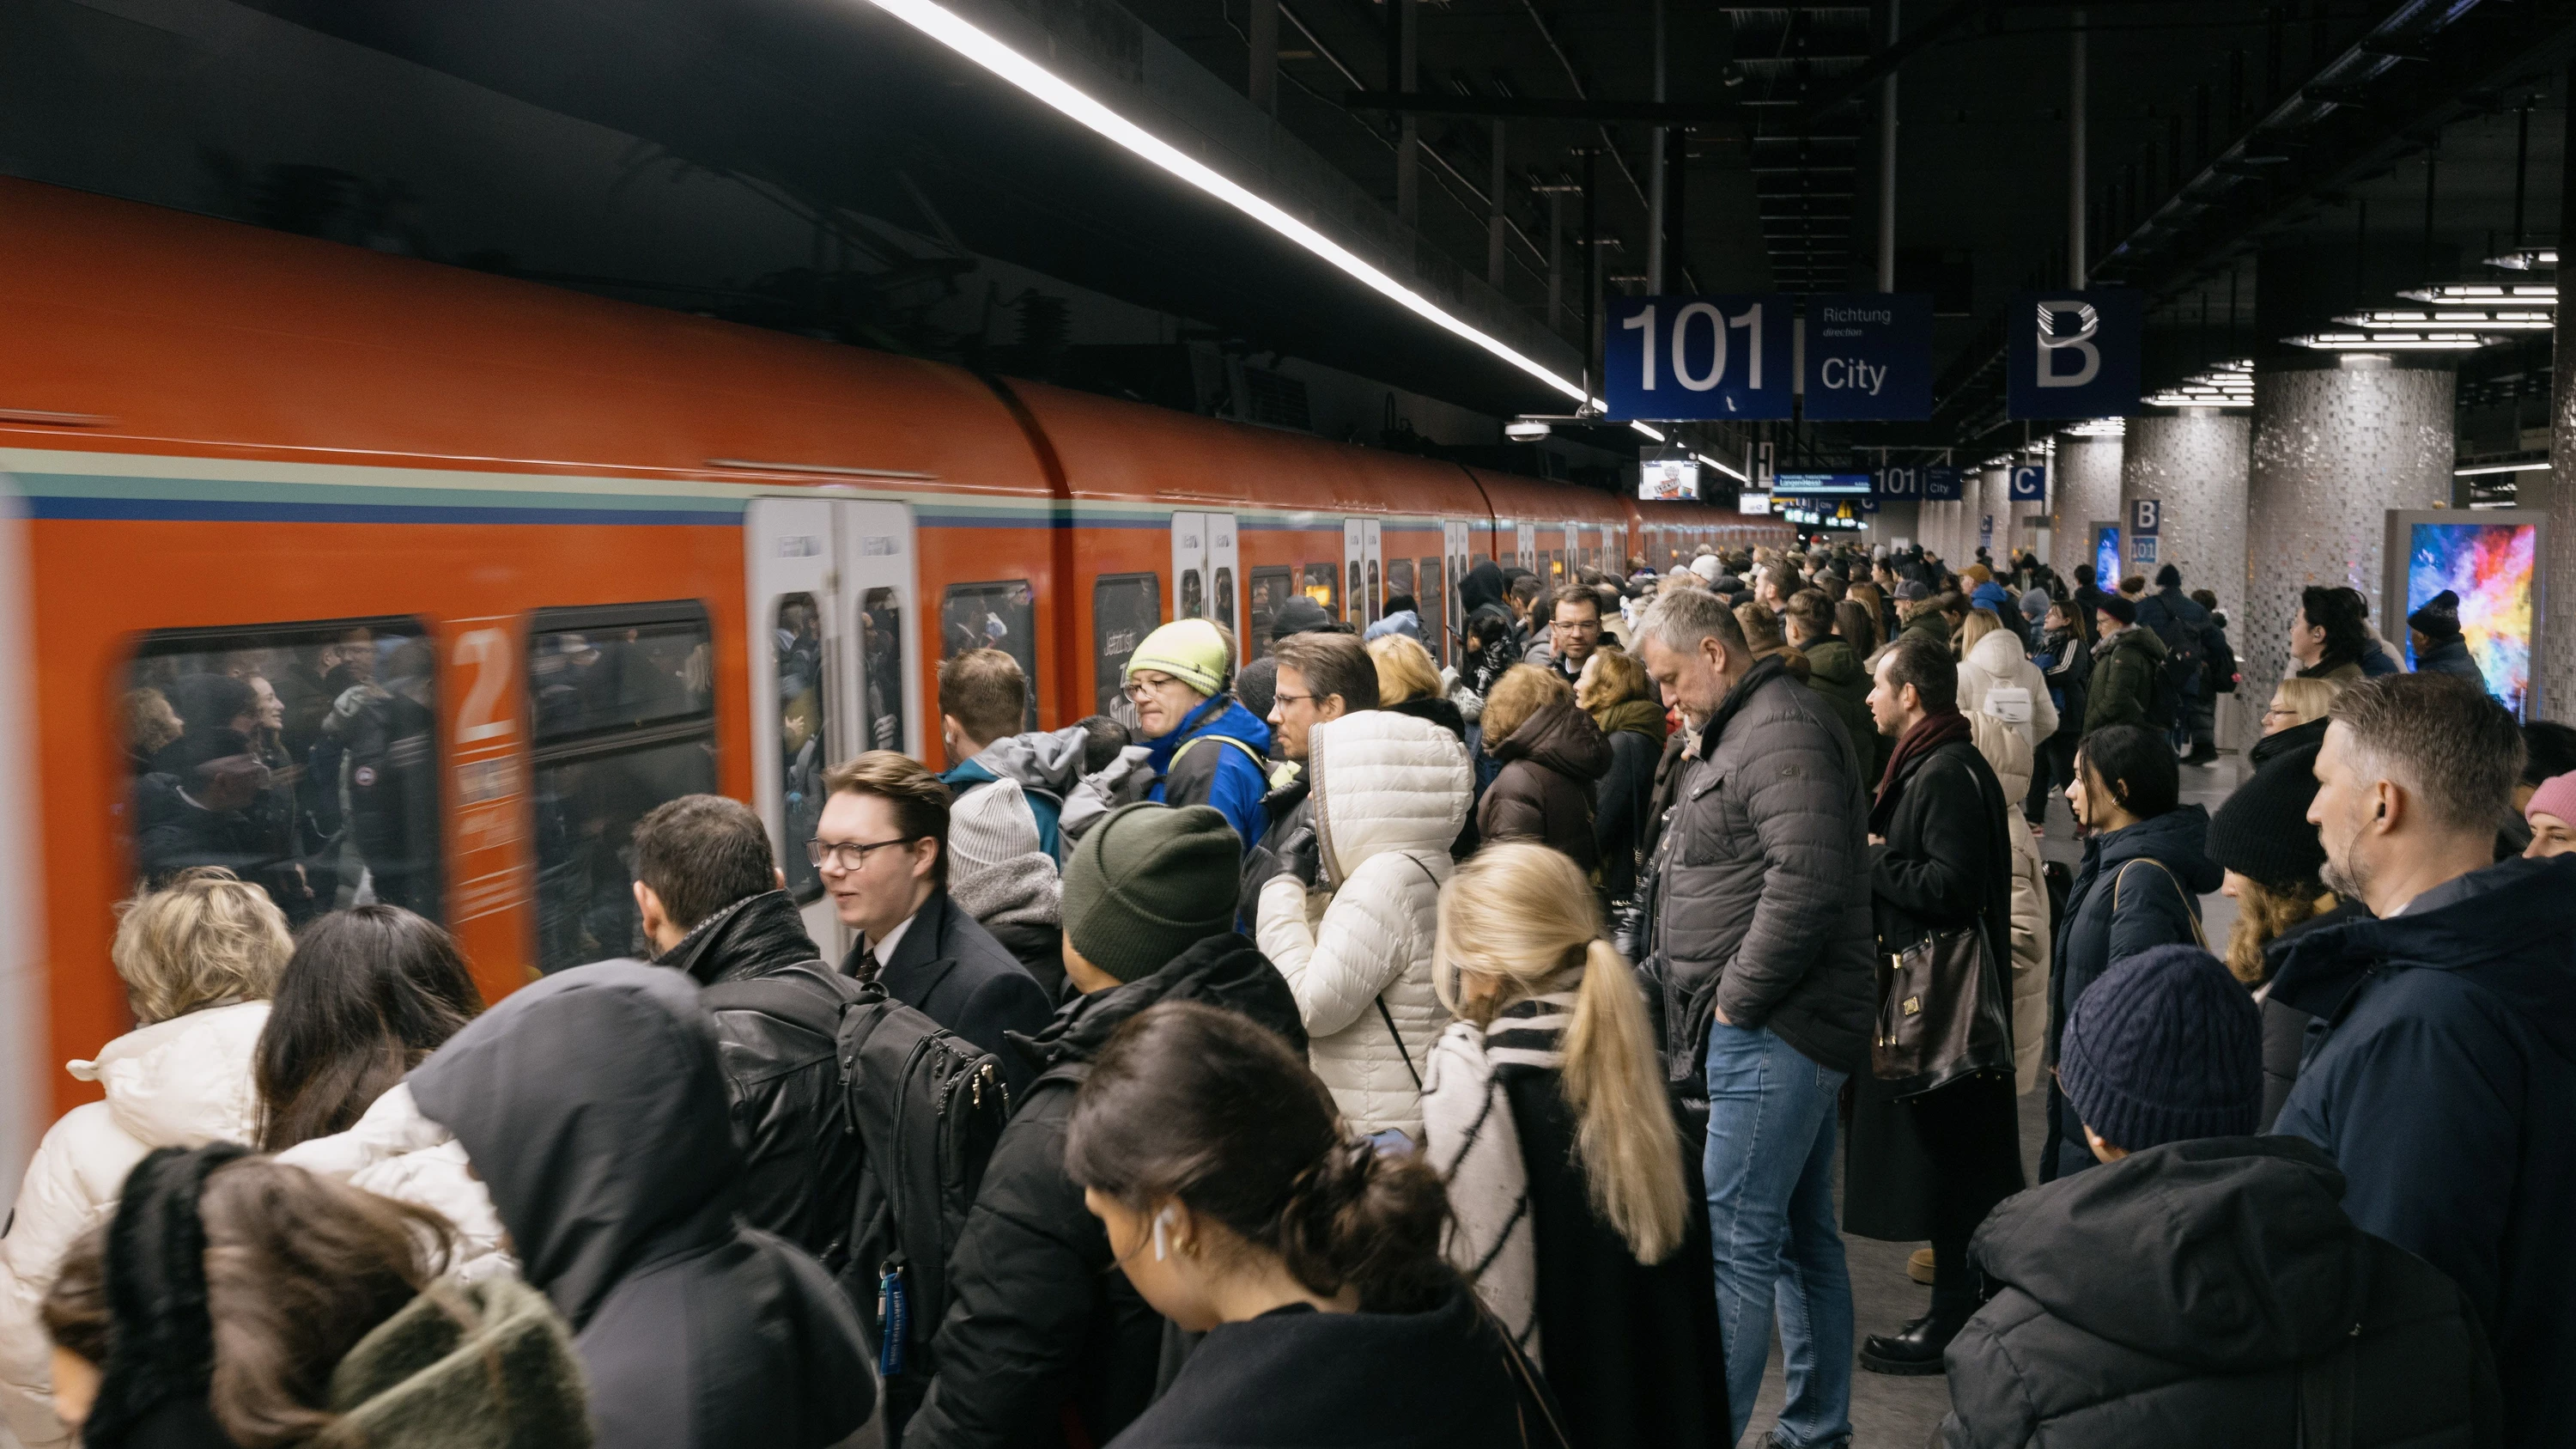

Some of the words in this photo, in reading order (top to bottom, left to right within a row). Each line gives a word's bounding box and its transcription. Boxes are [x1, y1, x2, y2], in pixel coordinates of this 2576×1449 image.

[1823, 307, 1891, 326] Richtung
[1823, 327, 1862, 338] direction
[2037, 301, 2100, 387] B
[1623, 301, 1763, 392] 101
[1821, 357, 1887, 396] City
[1874, 467, 1915, 494] 101
[1929, 482, 1949, 495] City
[2014, 467, 2036, 494] C
[2138, 501, 2156, 528] B
[451, 626, 516, 745] 2
